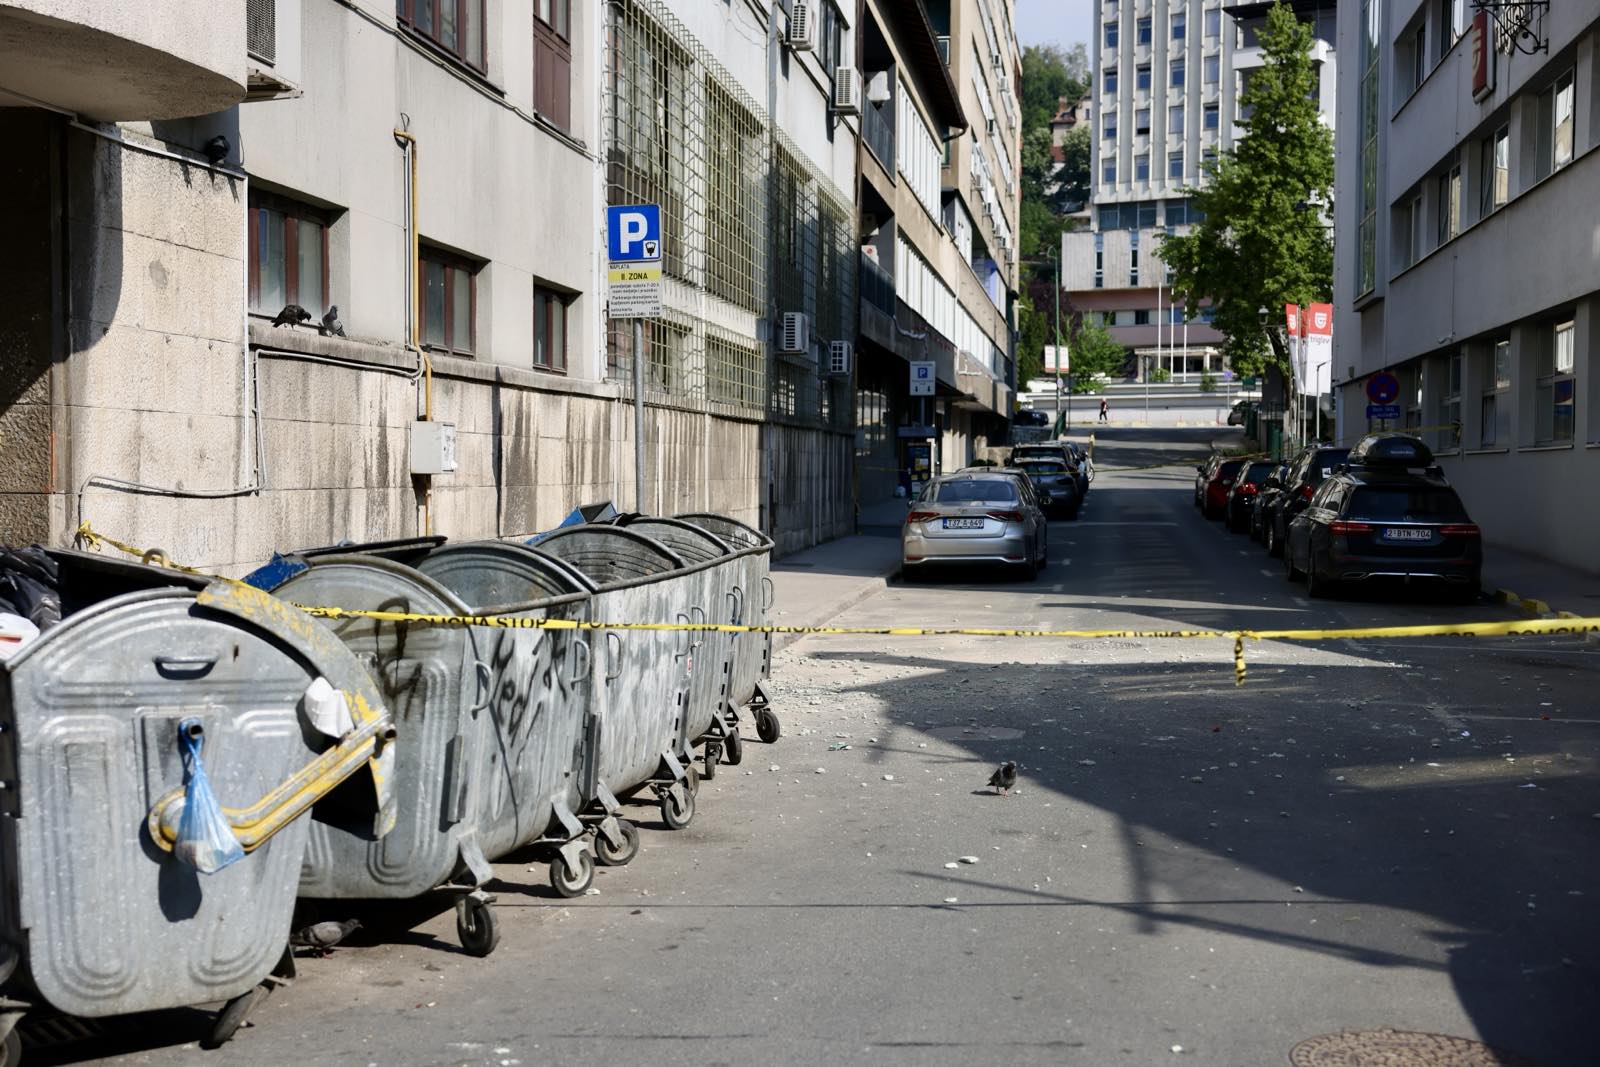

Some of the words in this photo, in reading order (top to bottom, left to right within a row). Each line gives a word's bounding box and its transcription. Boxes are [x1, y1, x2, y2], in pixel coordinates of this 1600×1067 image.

[620, 212, 648, 253] P
[628, 272, 648, 280] ZONA
[919, 368, 926, 377] P
